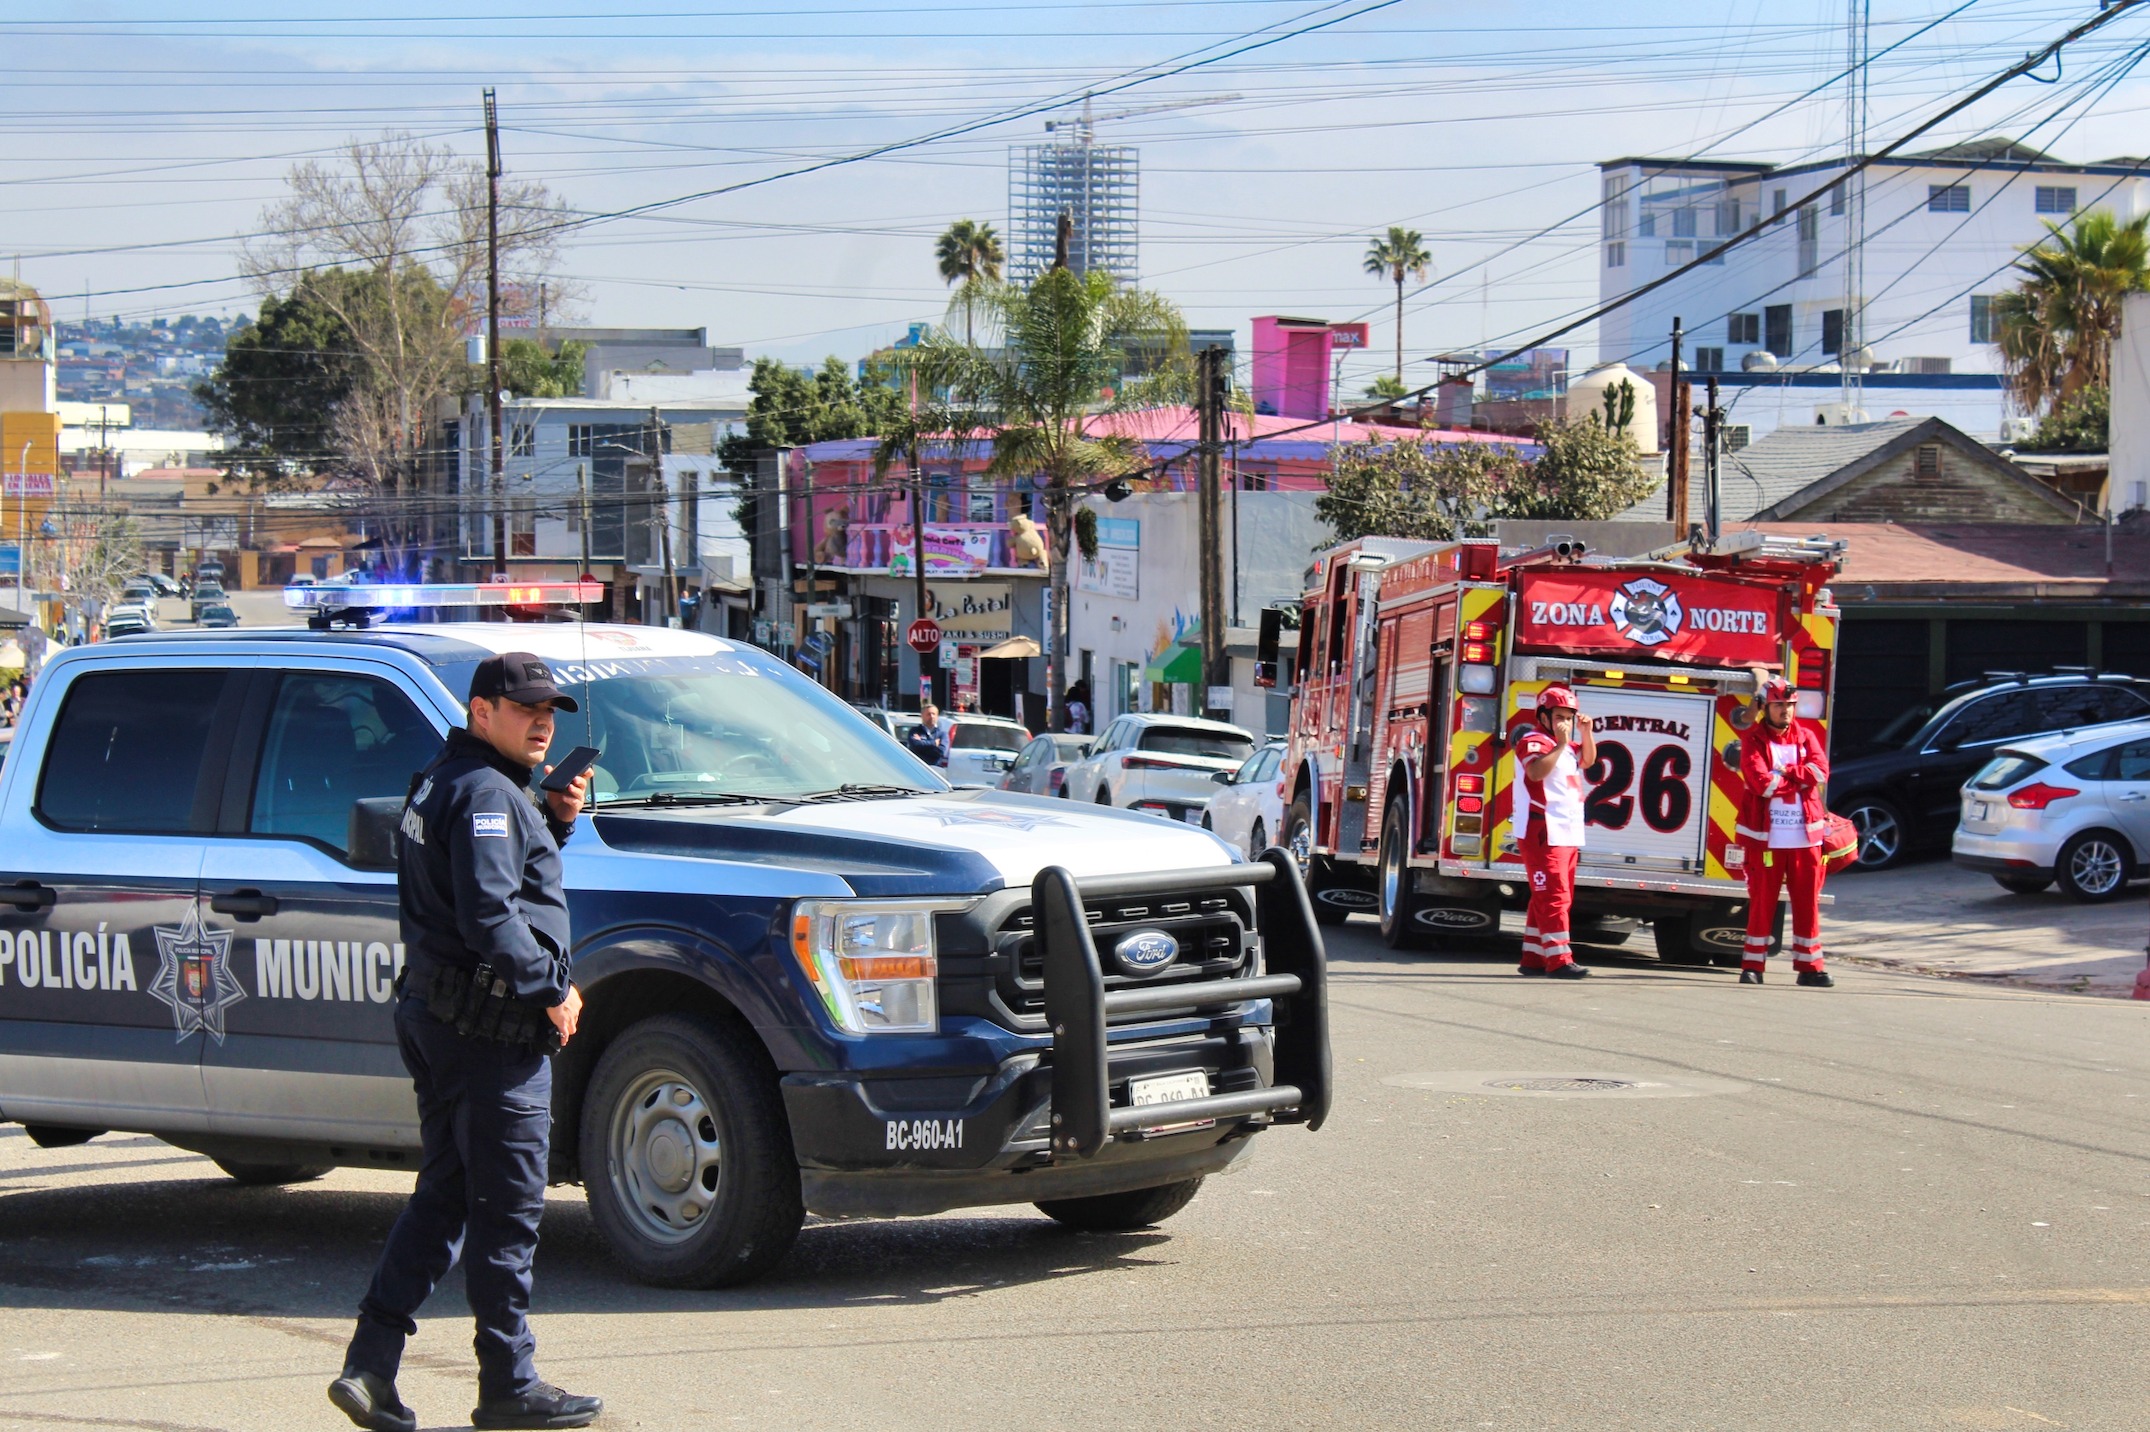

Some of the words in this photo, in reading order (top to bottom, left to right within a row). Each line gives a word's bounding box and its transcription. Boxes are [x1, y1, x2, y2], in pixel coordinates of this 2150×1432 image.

[934, 601, 956, 621] La
[962, 593, 1010, 614] Postal
[1531, 601, 1605, 626] ZONA
[1689, 608, 1767, 635] NORTE
[910, 628, 939, 643] ALTO
[978, 630, 1008, 640] SUSHI
[1592, 716, 1690, 741] CENTRAL
[1583, 740, 1691, 833] 26
[475, 817, 506, 826] POLICÍA
[1770, 809, 1789, 817] CRUZ
[1331, 892, 1372, 903] Pierce
[1430, 910, 1479, 924] Pierce
[0, 921, 138, 991] POLICÍA
[1136, 940, 1167, 961] Ford
[886, 1119, 964, 1150] BC-960-A1
